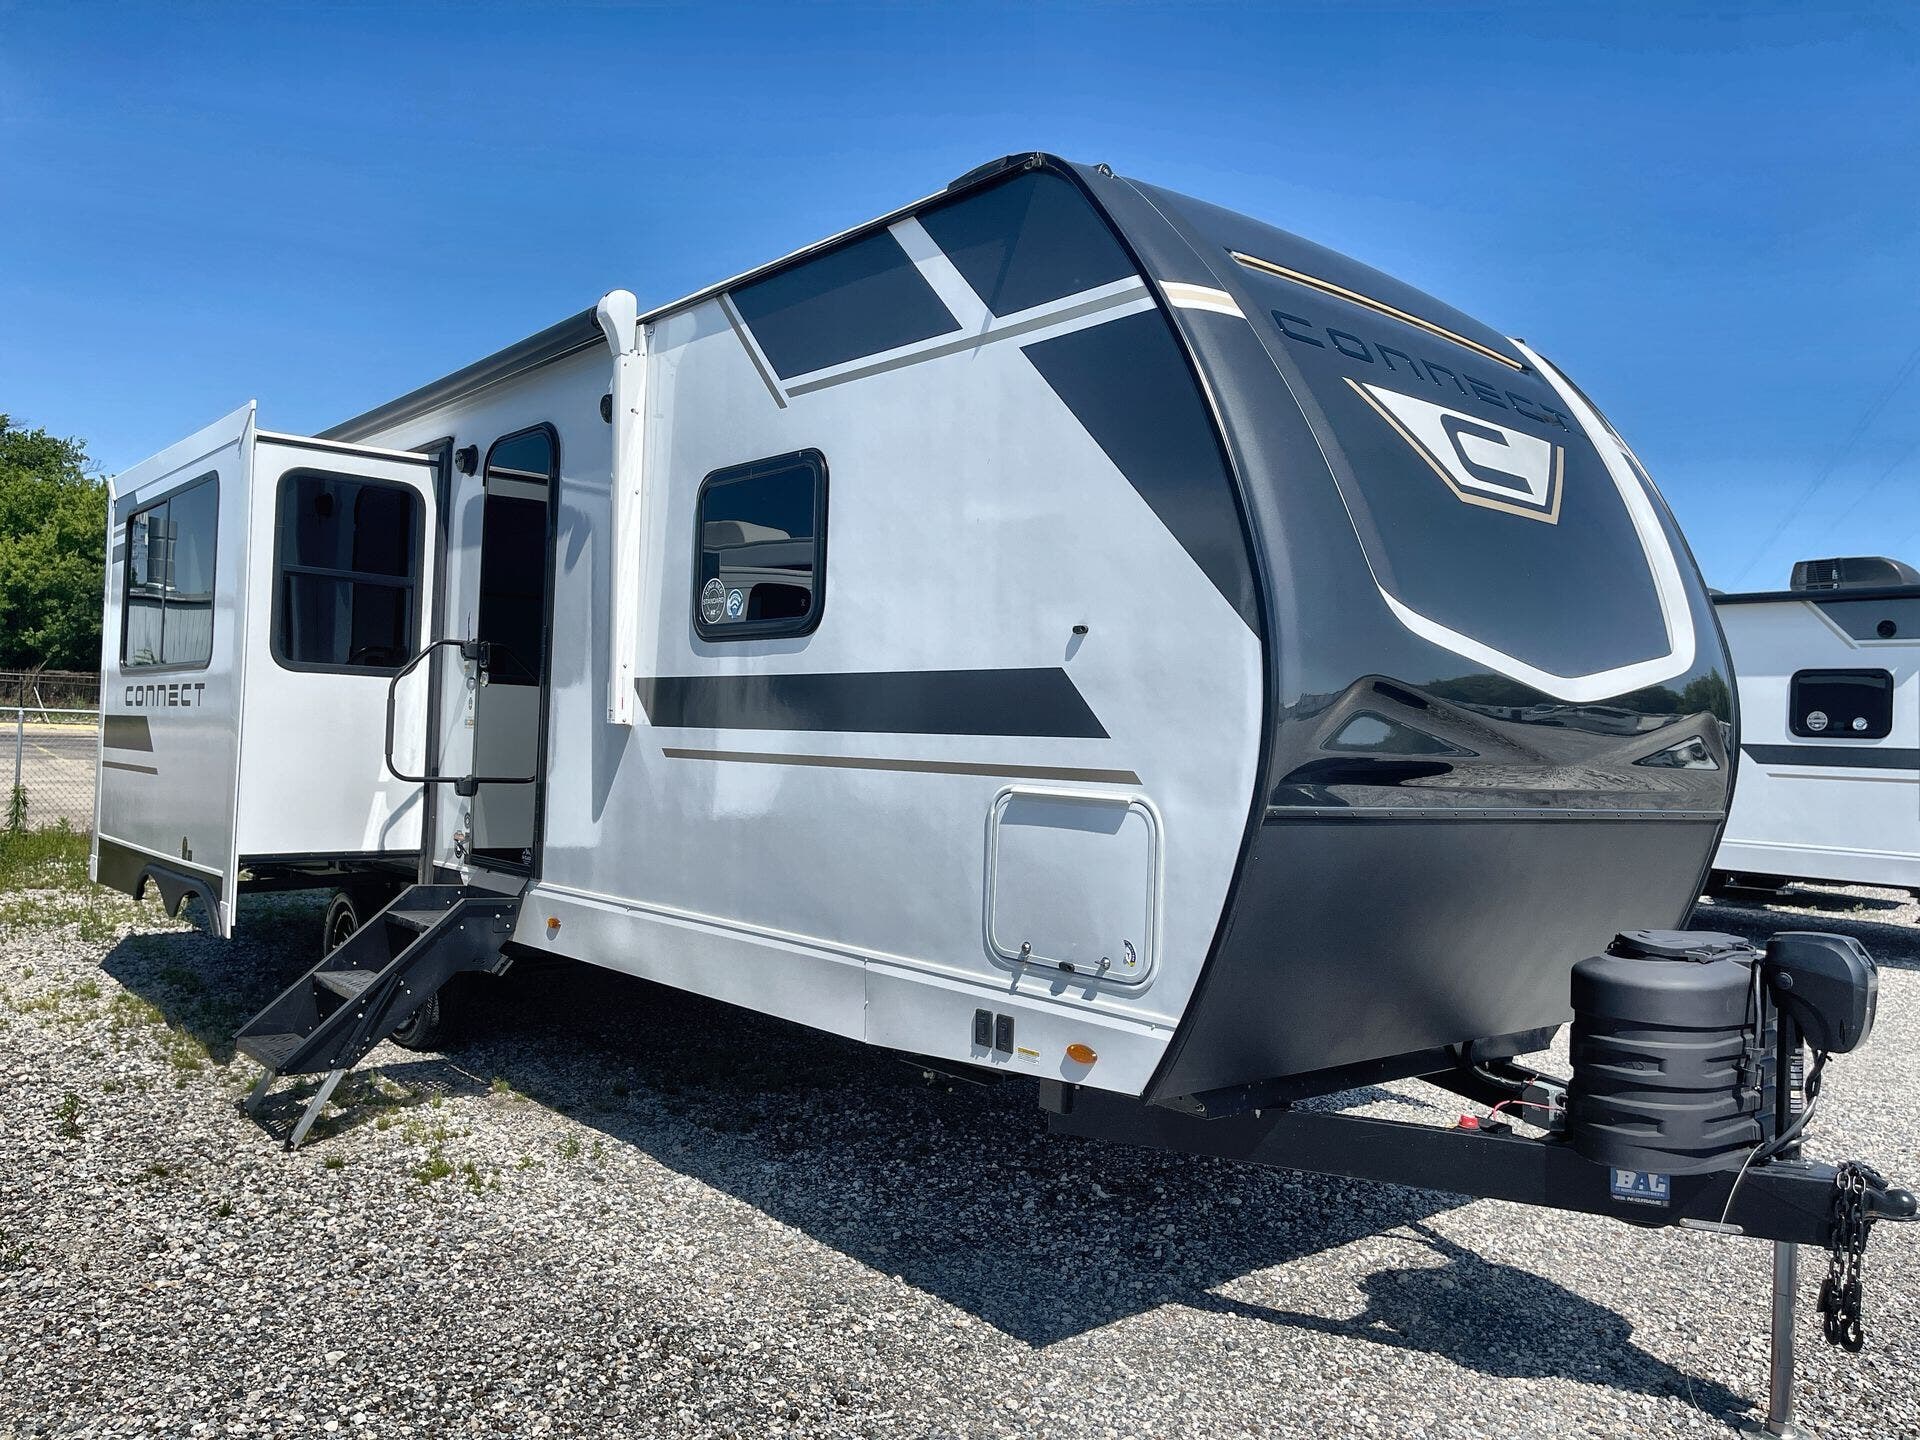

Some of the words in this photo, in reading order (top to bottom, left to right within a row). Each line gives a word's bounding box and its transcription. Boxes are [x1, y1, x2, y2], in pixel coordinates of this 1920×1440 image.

[1270, 309, 1570, 433] CONNECT
[125, 683, 205, 707] CONNECT
[1615, 1169, 1666, 1193] BAL
